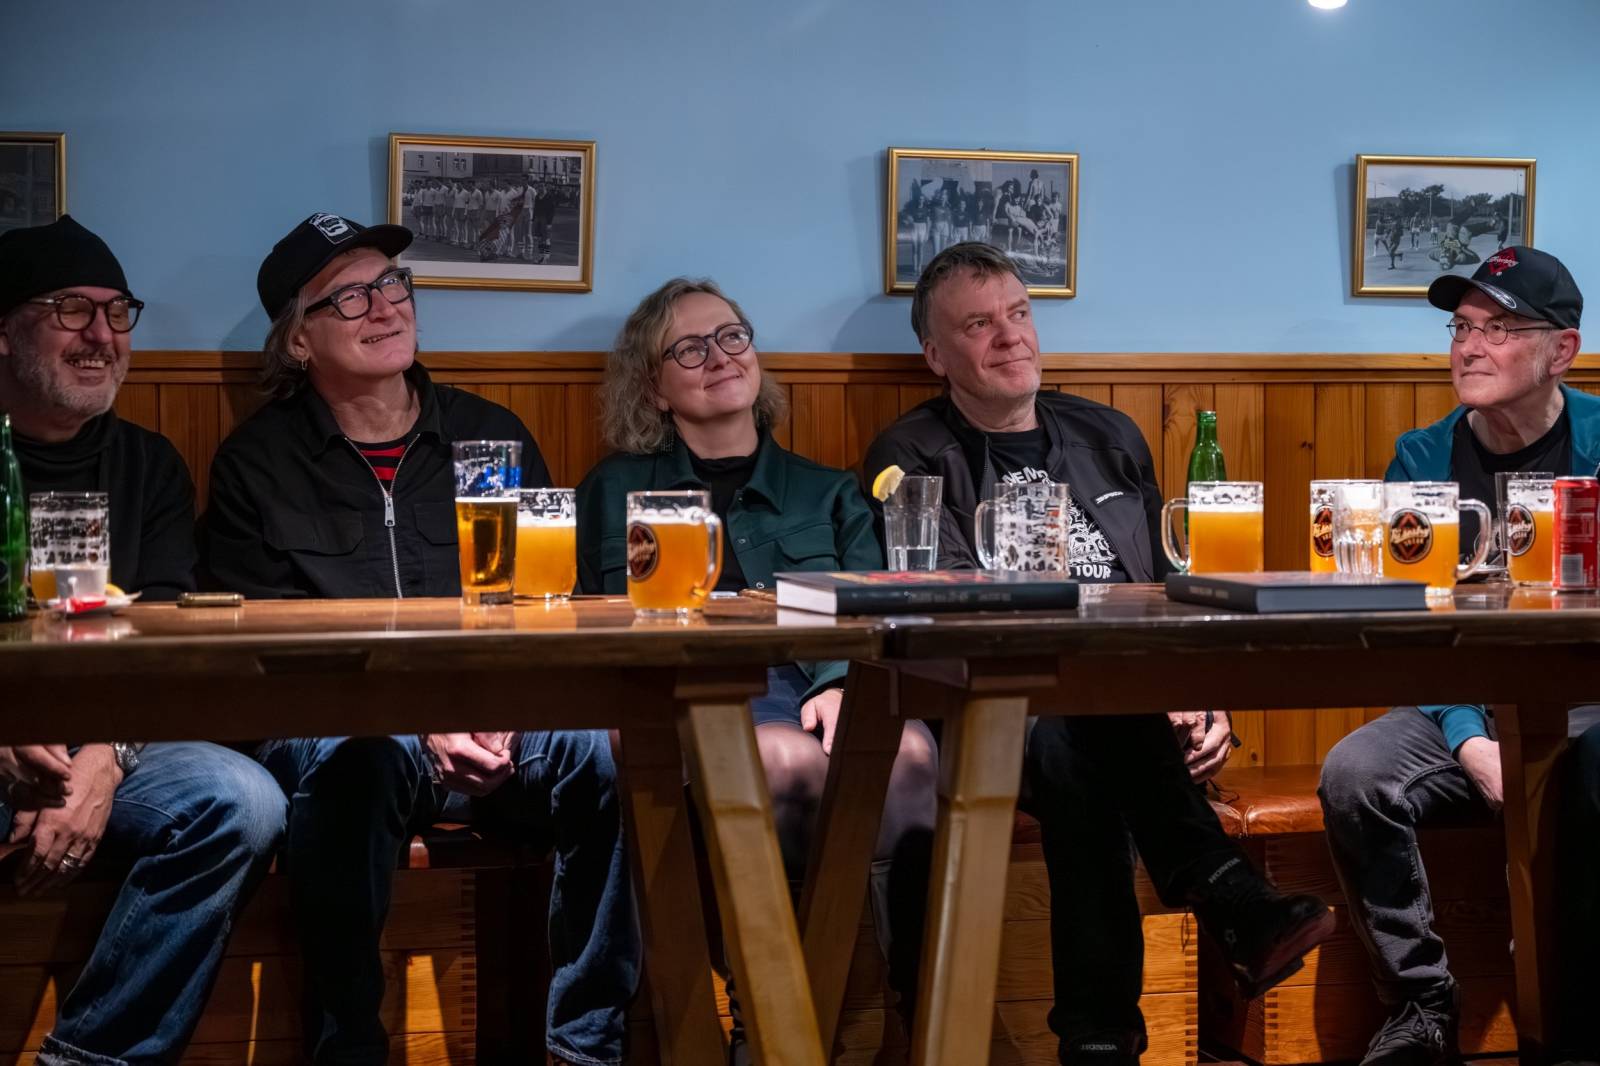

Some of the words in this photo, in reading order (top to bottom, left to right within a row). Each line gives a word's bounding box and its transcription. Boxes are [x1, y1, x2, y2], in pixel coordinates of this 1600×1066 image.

[1075, 564, 1111, 579] TOUR
[1208, 857, 1241, 884] HONDA
[1080, 1043, 1118, 1052] HONDA
